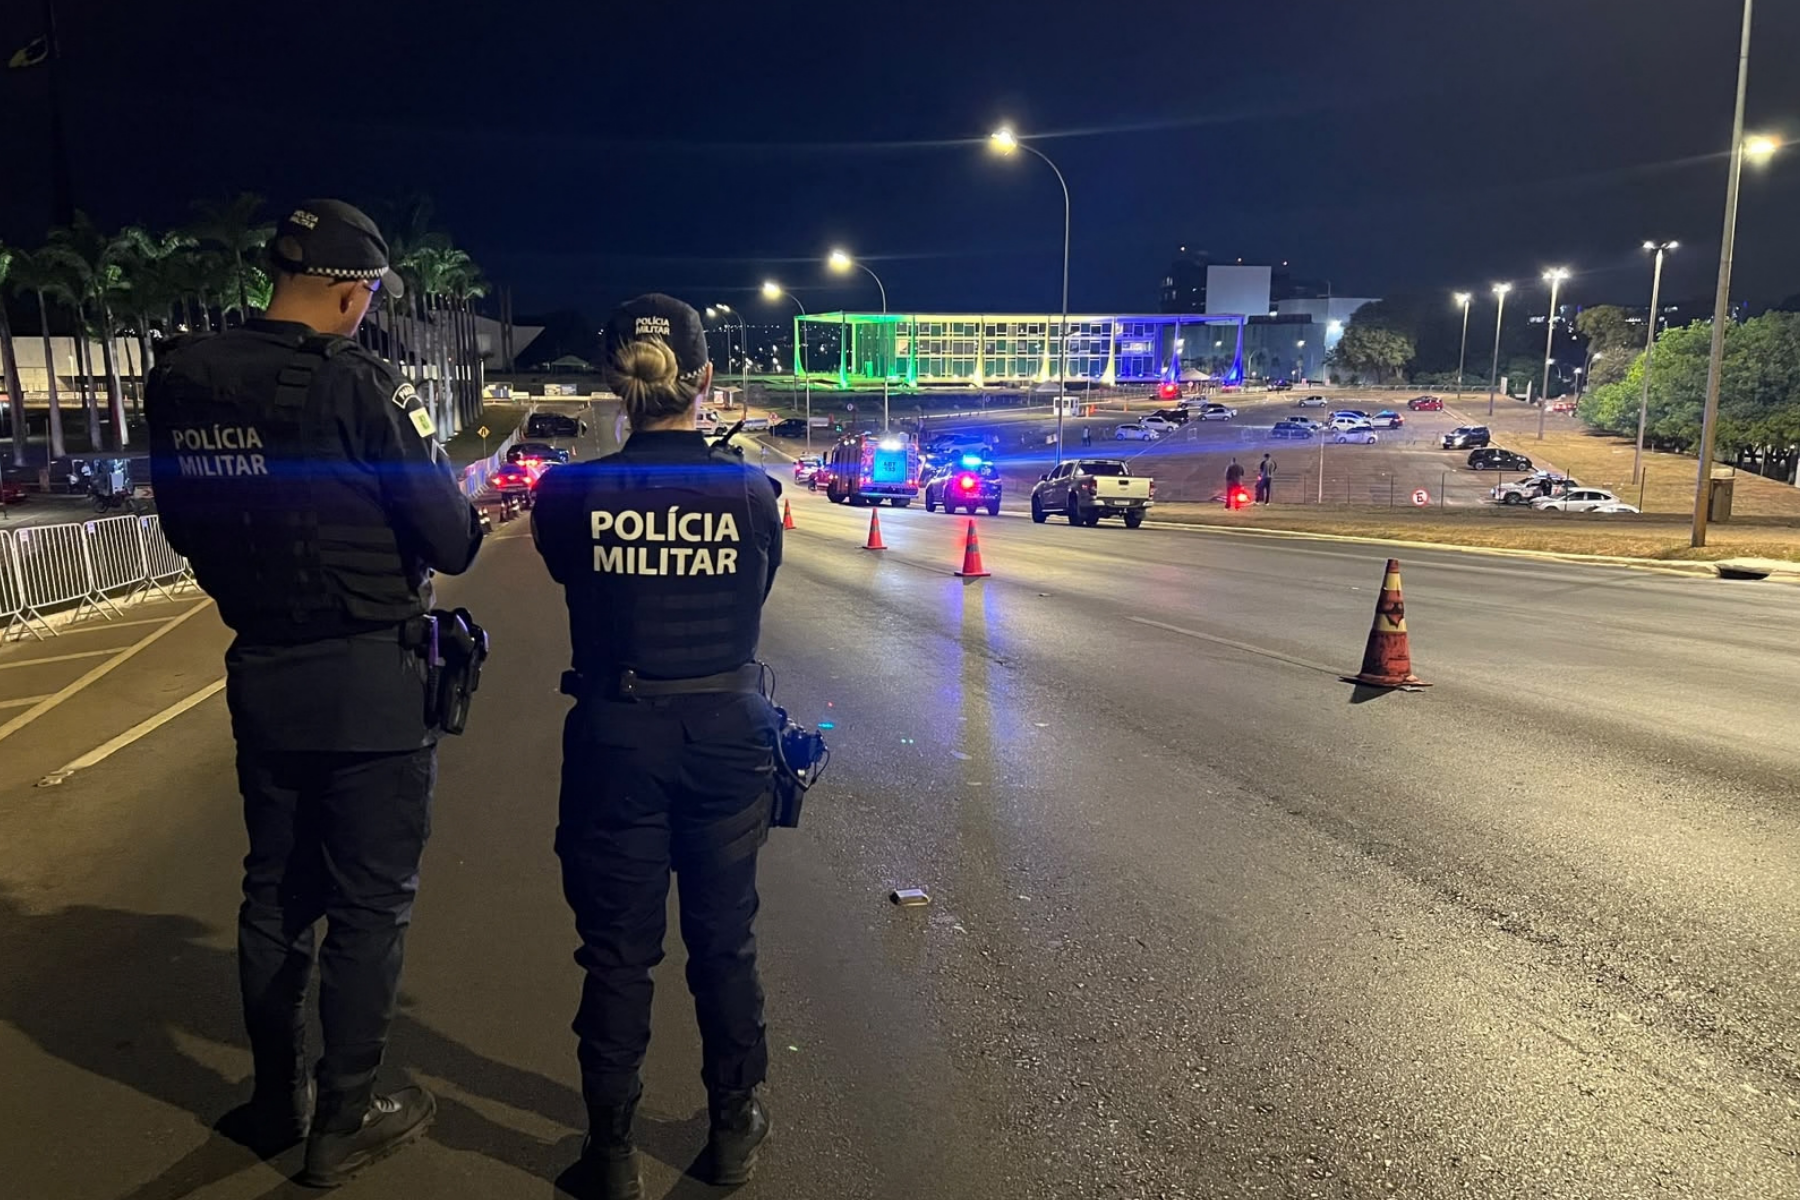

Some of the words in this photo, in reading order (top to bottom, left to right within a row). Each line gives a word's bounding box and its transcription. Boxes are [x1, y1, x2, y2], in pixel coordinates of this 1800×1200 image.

[635, 316, 669, 327] POLÍCIA
[635, 325, 670, 335] MILITAR
[172, 424, 263, 450] POLÍCIA
[178, 454, 268, 476] MILITAR
[591, 505, 740, 542] POLÍCIA
[593, 545, 738, 576] MILITAR
